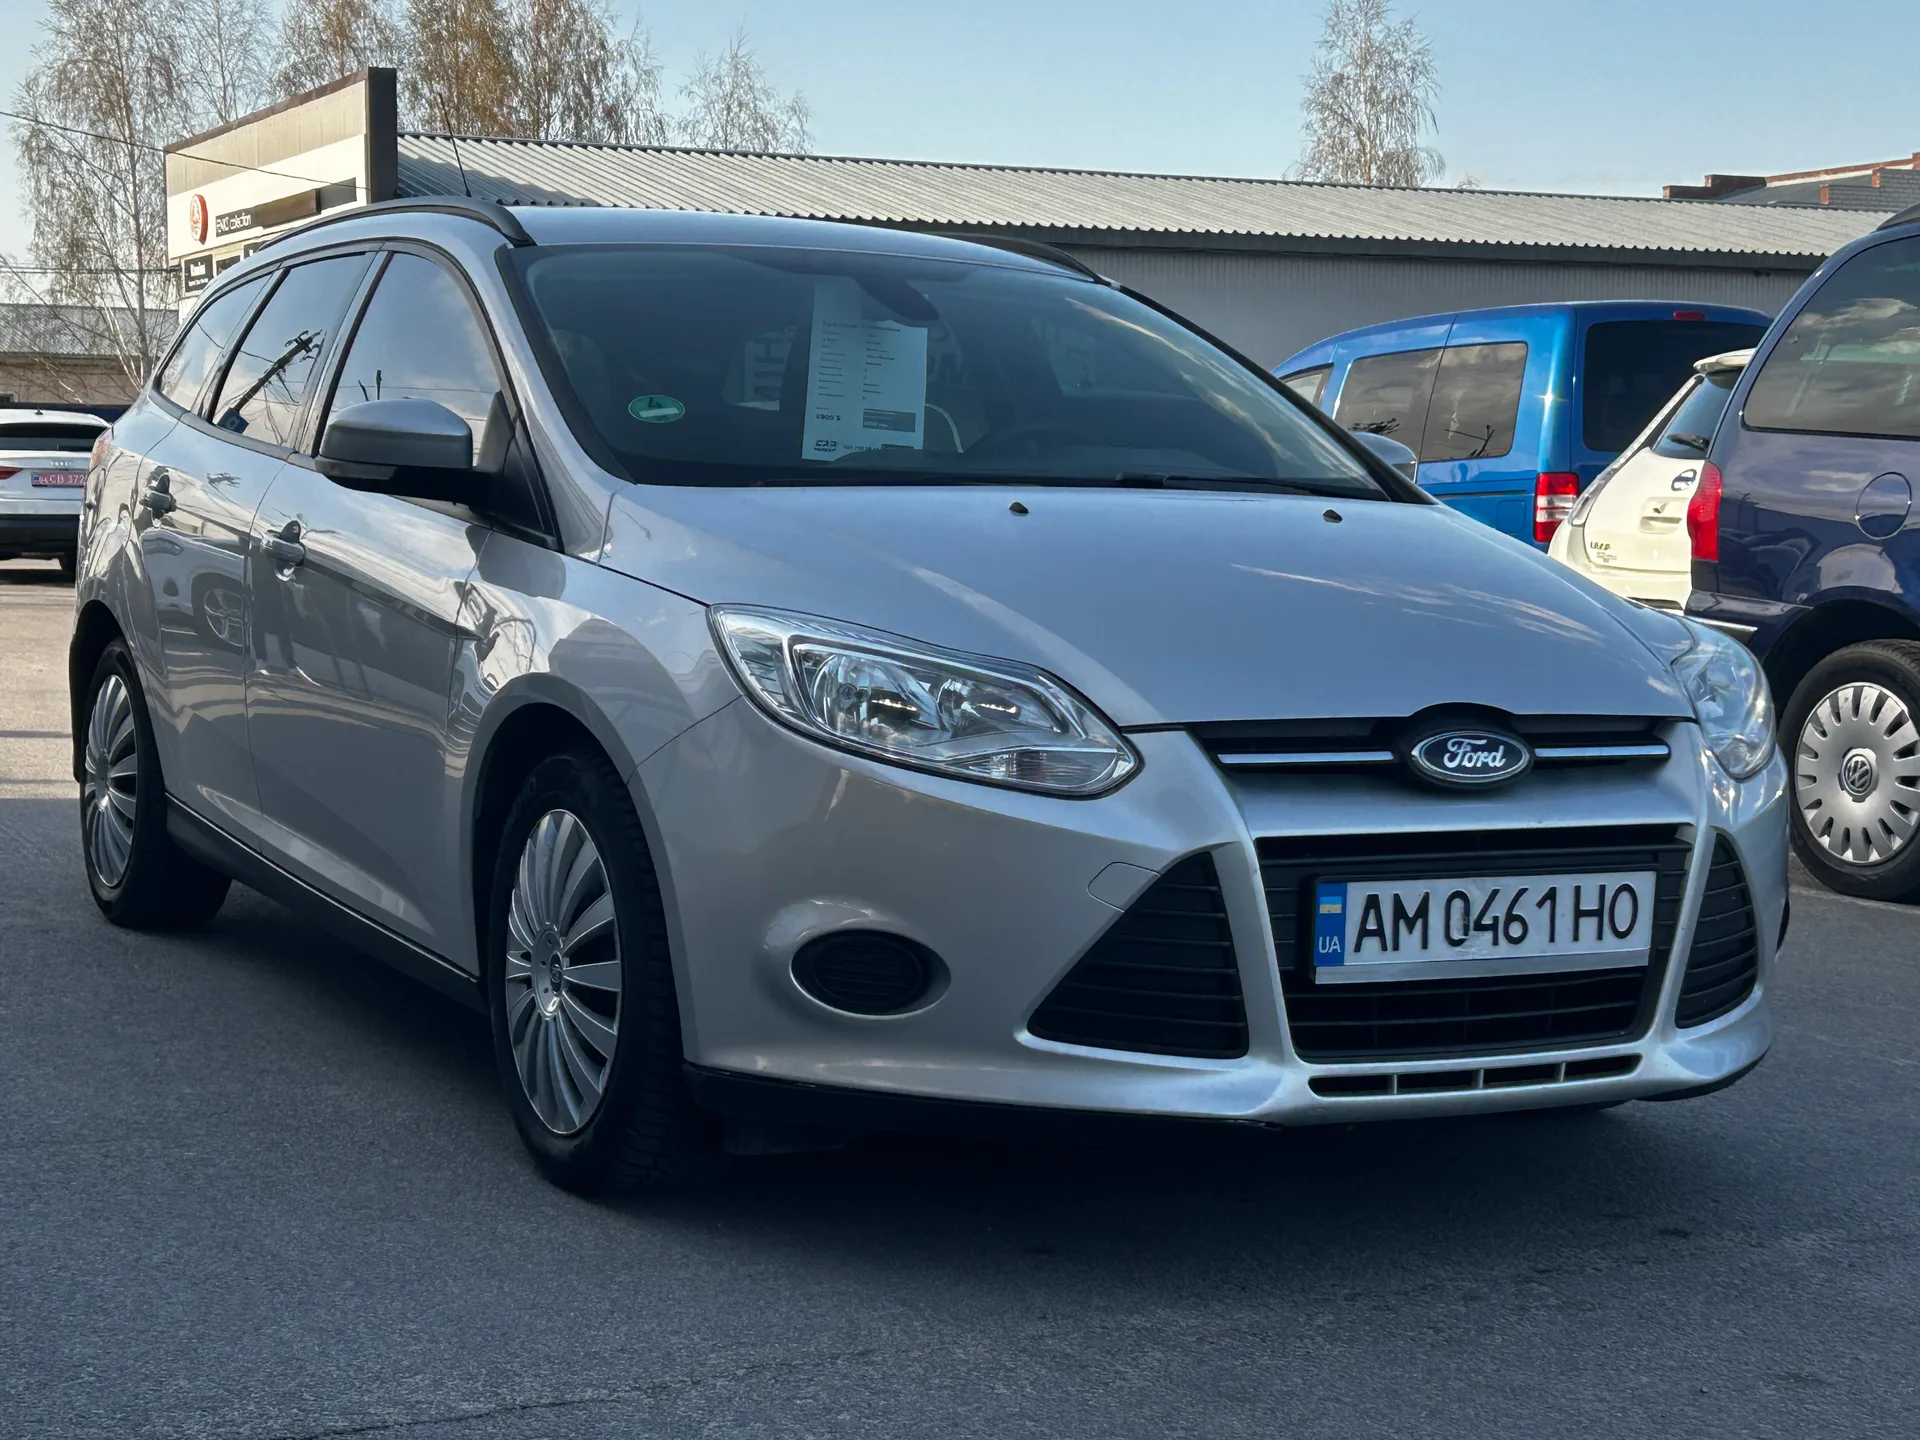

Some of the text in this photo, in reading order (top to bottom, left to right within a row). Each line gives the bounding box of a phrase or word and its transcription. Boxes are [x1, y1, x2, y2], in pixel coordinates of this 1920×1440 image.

[1443, 737, 1506, 768] Ford
[1354, 882, 1639, 952] AM 0461 HO
[1318, 936, 1341, 954] UA
